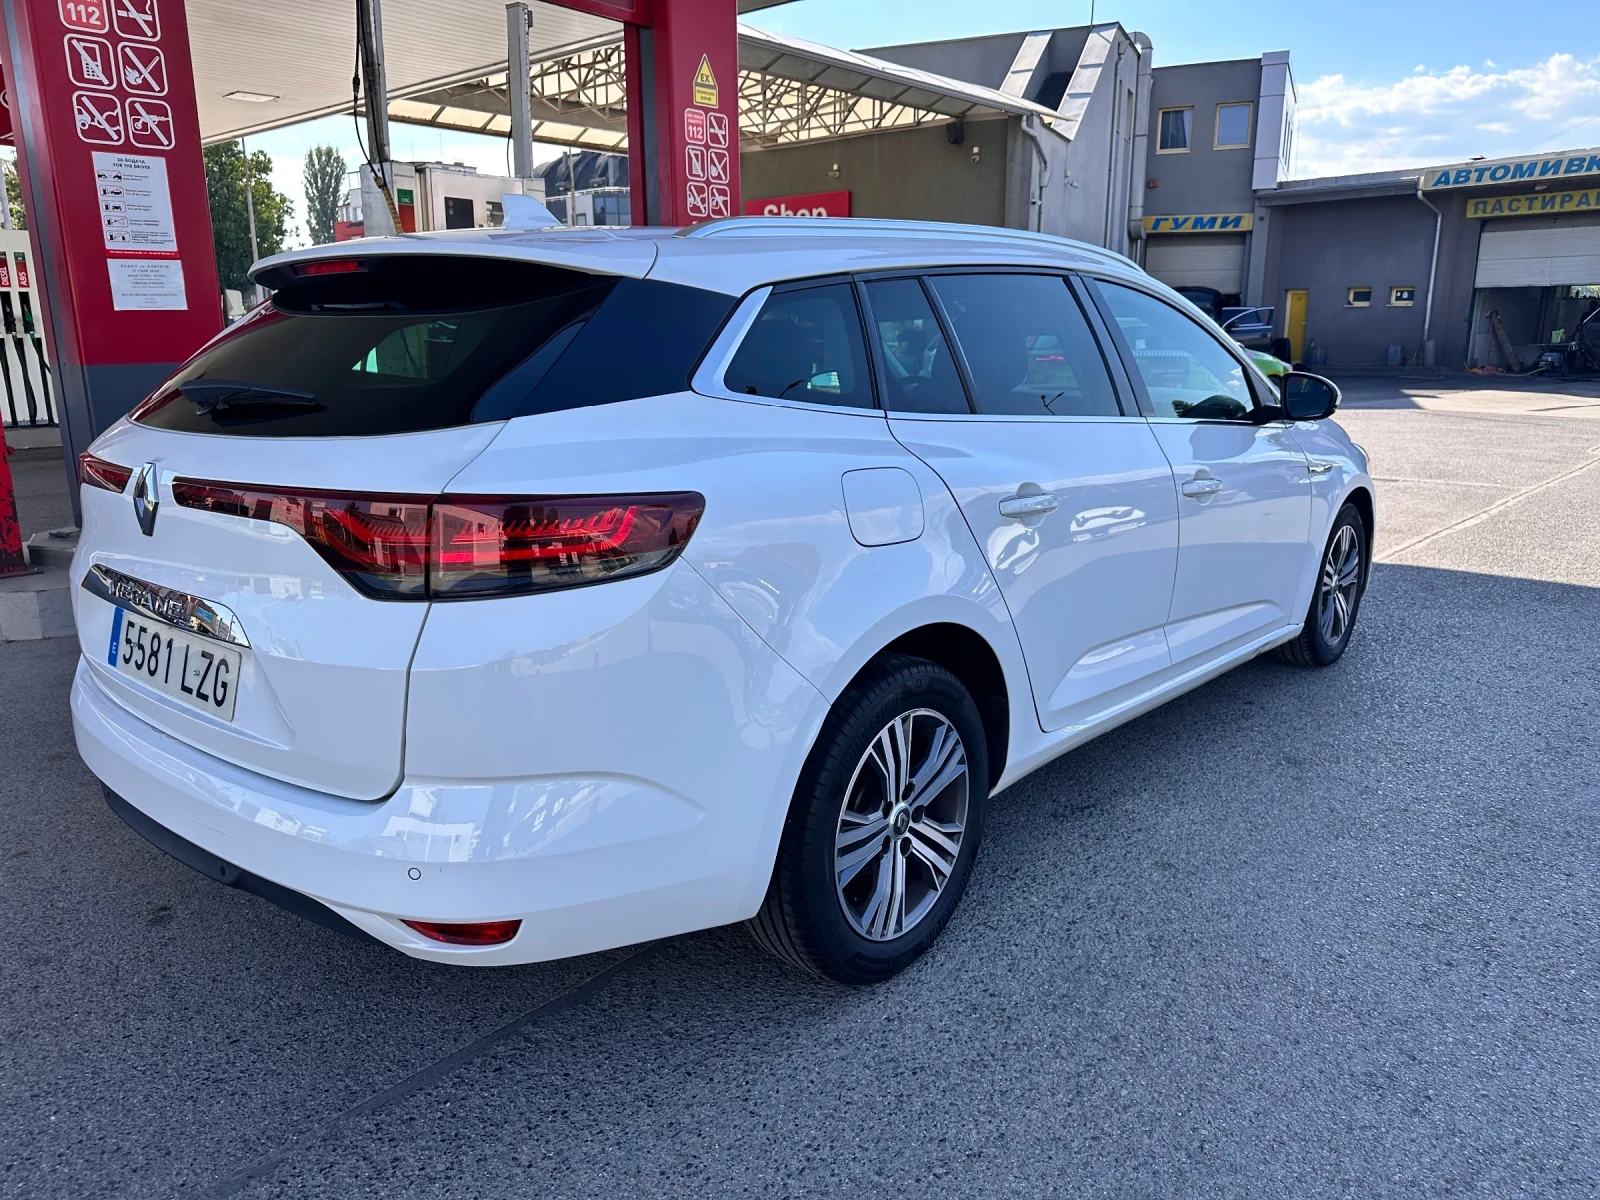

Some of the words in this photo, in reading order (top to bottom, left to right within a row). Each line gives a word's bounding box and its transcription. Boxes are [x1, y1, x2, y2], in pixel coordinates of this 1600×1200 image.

[66, 2, 101, 25] 112
[700, 73, 711, 84] EX
[687, 126, 703, 140] 112
[1151, 215, 1243, 231] ГУМИ
[18, 271, 28, 286] A95
[108, 578, 184, 620] MEGANE
[122, 620, 174, 684] 5581
[180, 643, 230, 707] LZG
